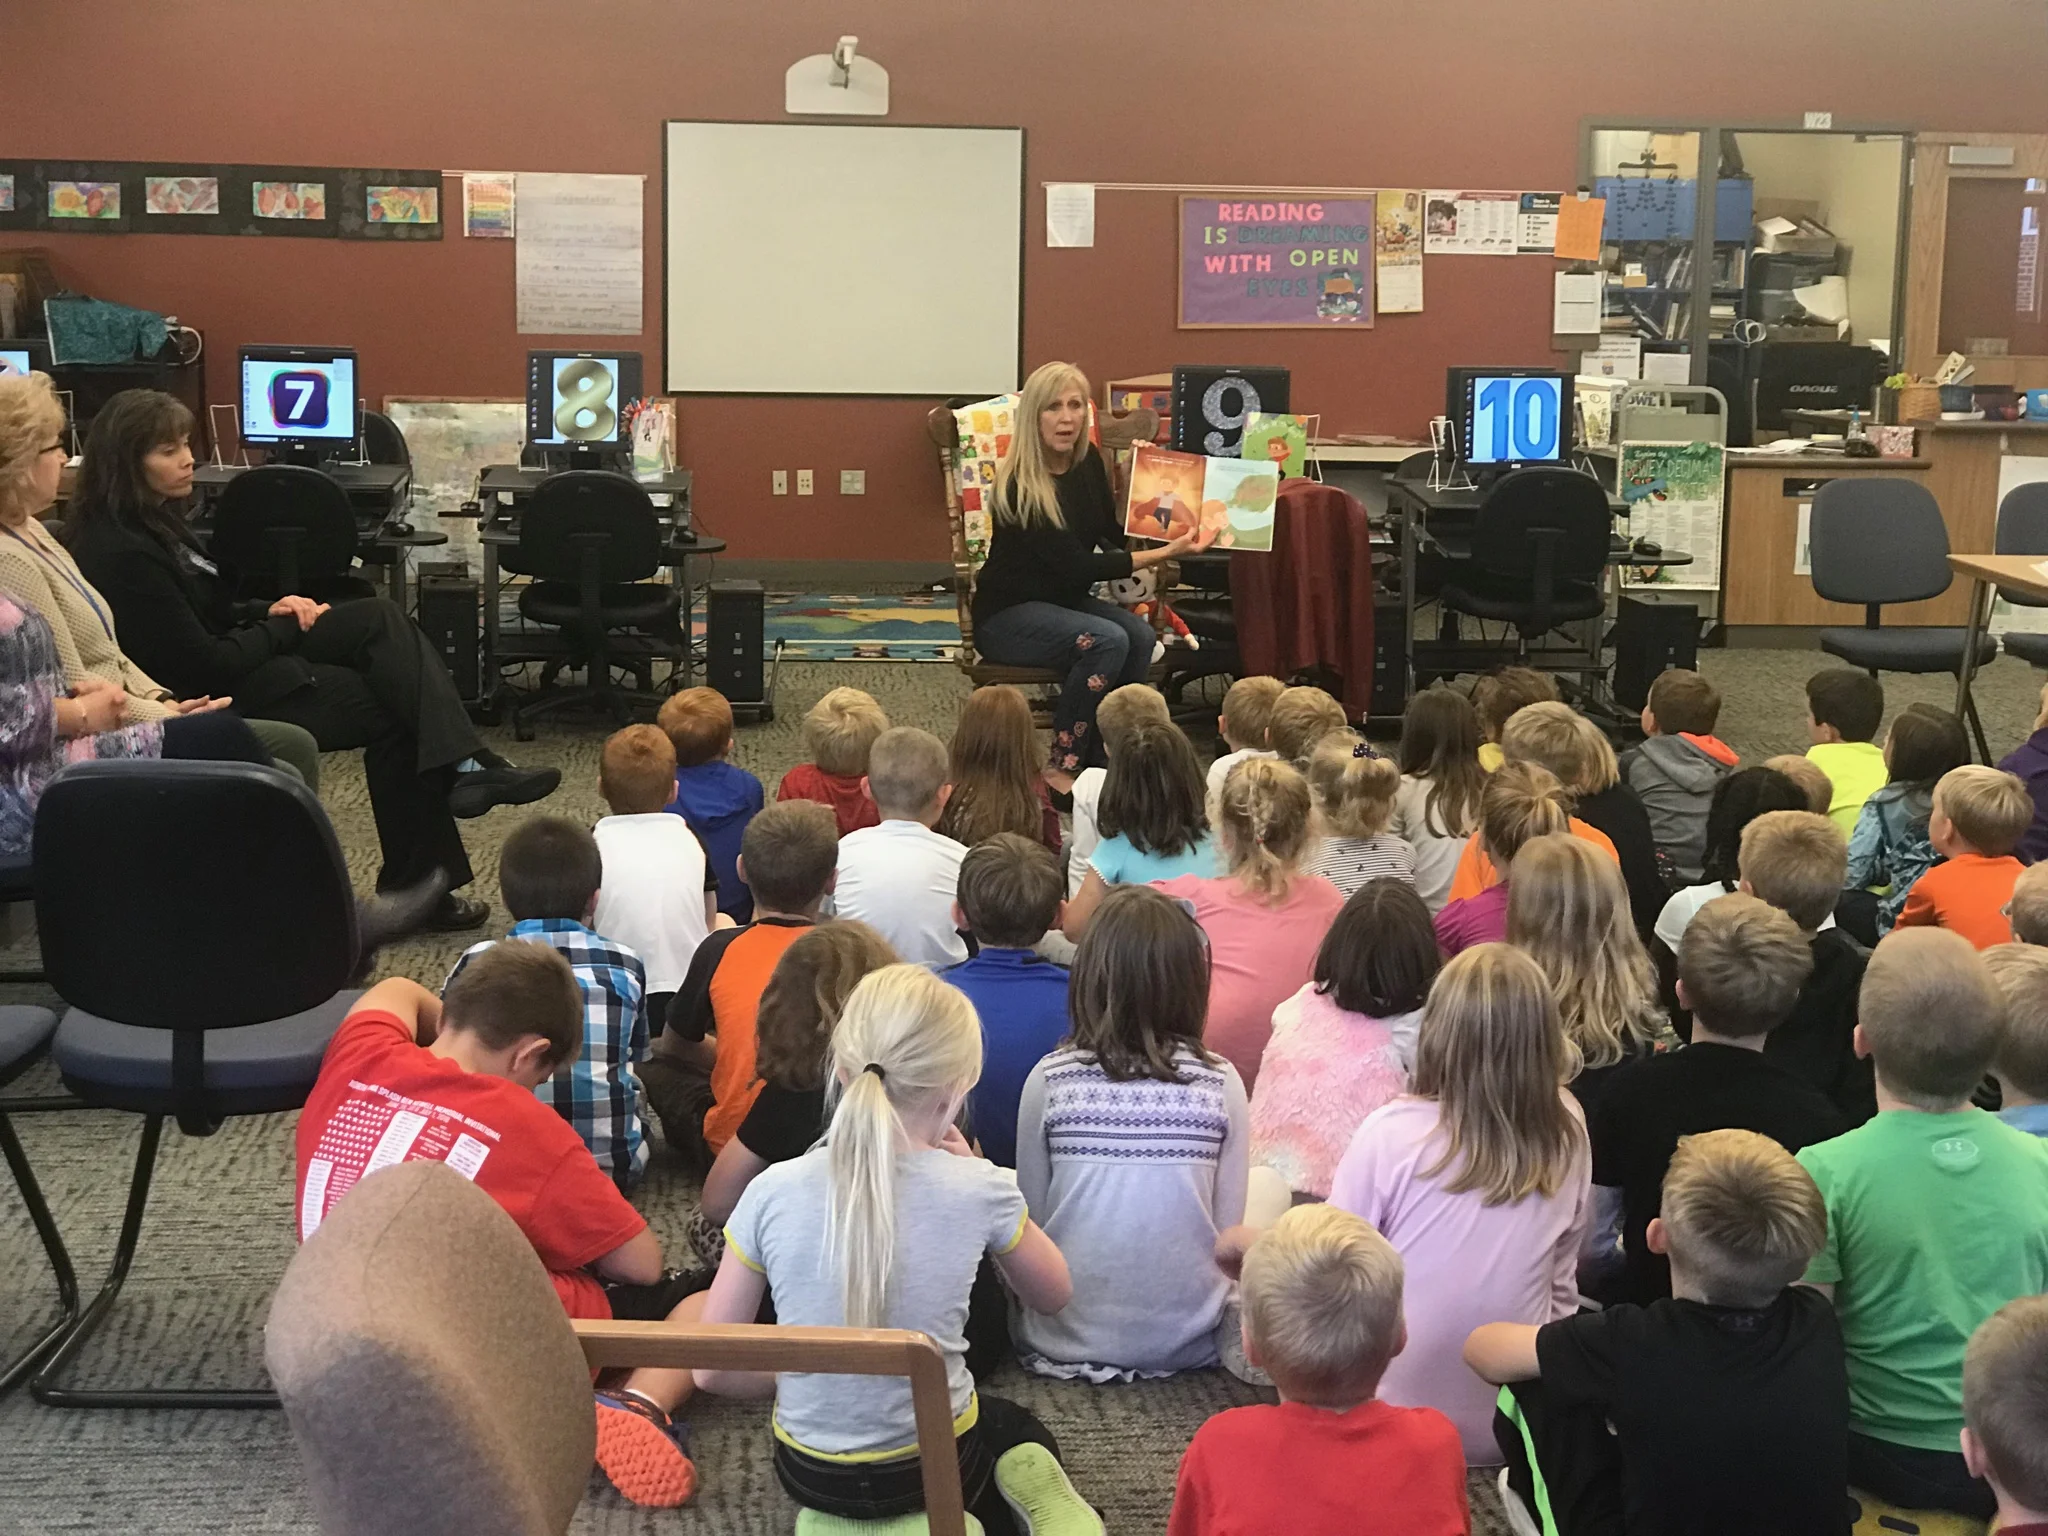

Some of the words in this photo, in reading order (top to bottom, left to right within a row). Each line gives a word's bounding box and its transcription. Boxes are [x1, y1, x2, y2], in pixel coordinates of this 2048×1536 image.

[1218, 202, 1324, 222] READING
[1204, 227, 1227, 244] IS
[1238, 224, 1369, 244] DREAMING
[1204, 254, 1271, 274] WITH
[1289, 248, 1359, 267] OPEN
[1246, 278, 1308, 297] EYES
[285, 380, 314, 419] 7
[555, 359, 616, 441] 8
[1202, 377, 1261, 457] 9
[1480, 379, 1557, 460] 10
[1668, 459, 1717, 478] DECIMAL
[464, 1117, 501, 1142] INVITATIONAL
